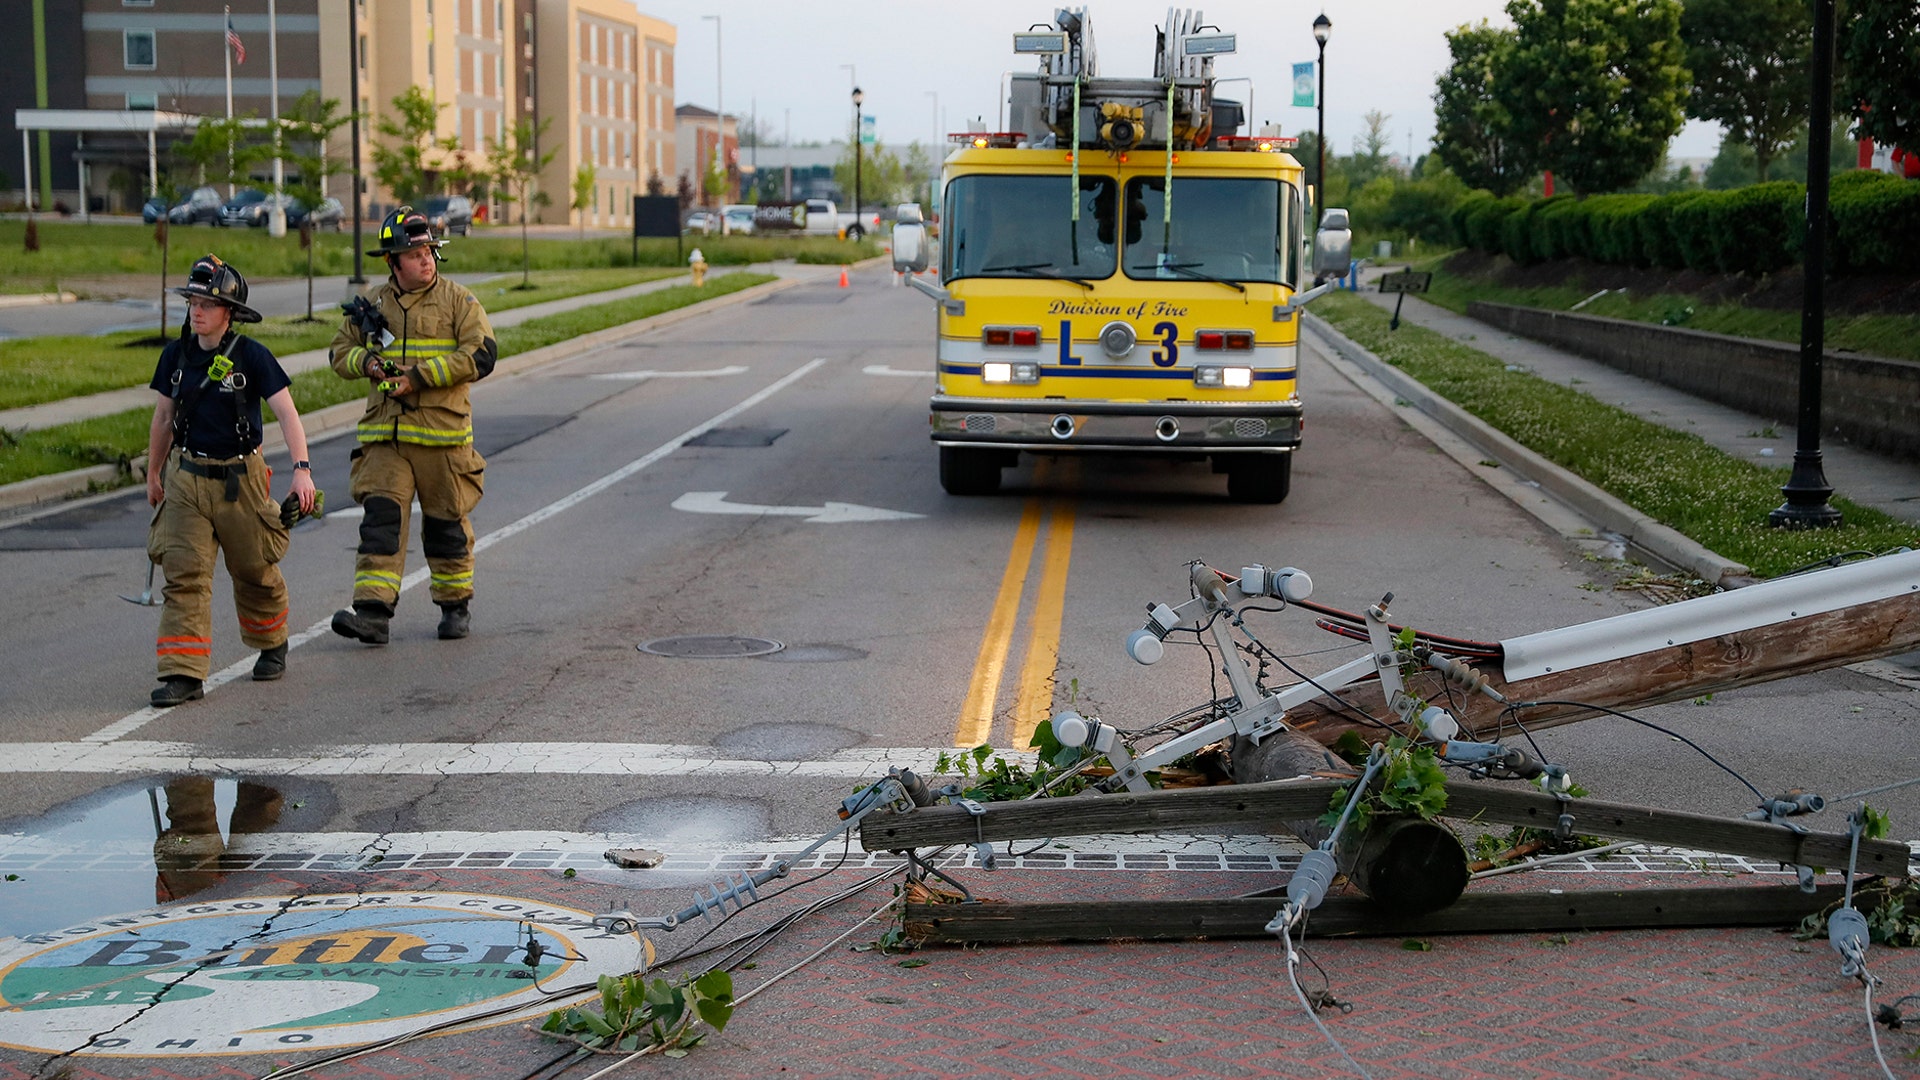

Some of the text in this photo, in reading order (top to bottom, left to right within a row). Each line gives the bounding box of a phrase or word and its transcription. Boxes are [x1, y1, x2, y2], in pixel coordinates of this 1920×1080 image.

[1047, 300, 1189, 321] Division of Fire
[1059, 320, 1179, 368] L 3
[16, 896, 437, 944] MONTGOMERY
[63, 936, 551, 967] Butler
[92, 1033, 314, 1049] OHIO
